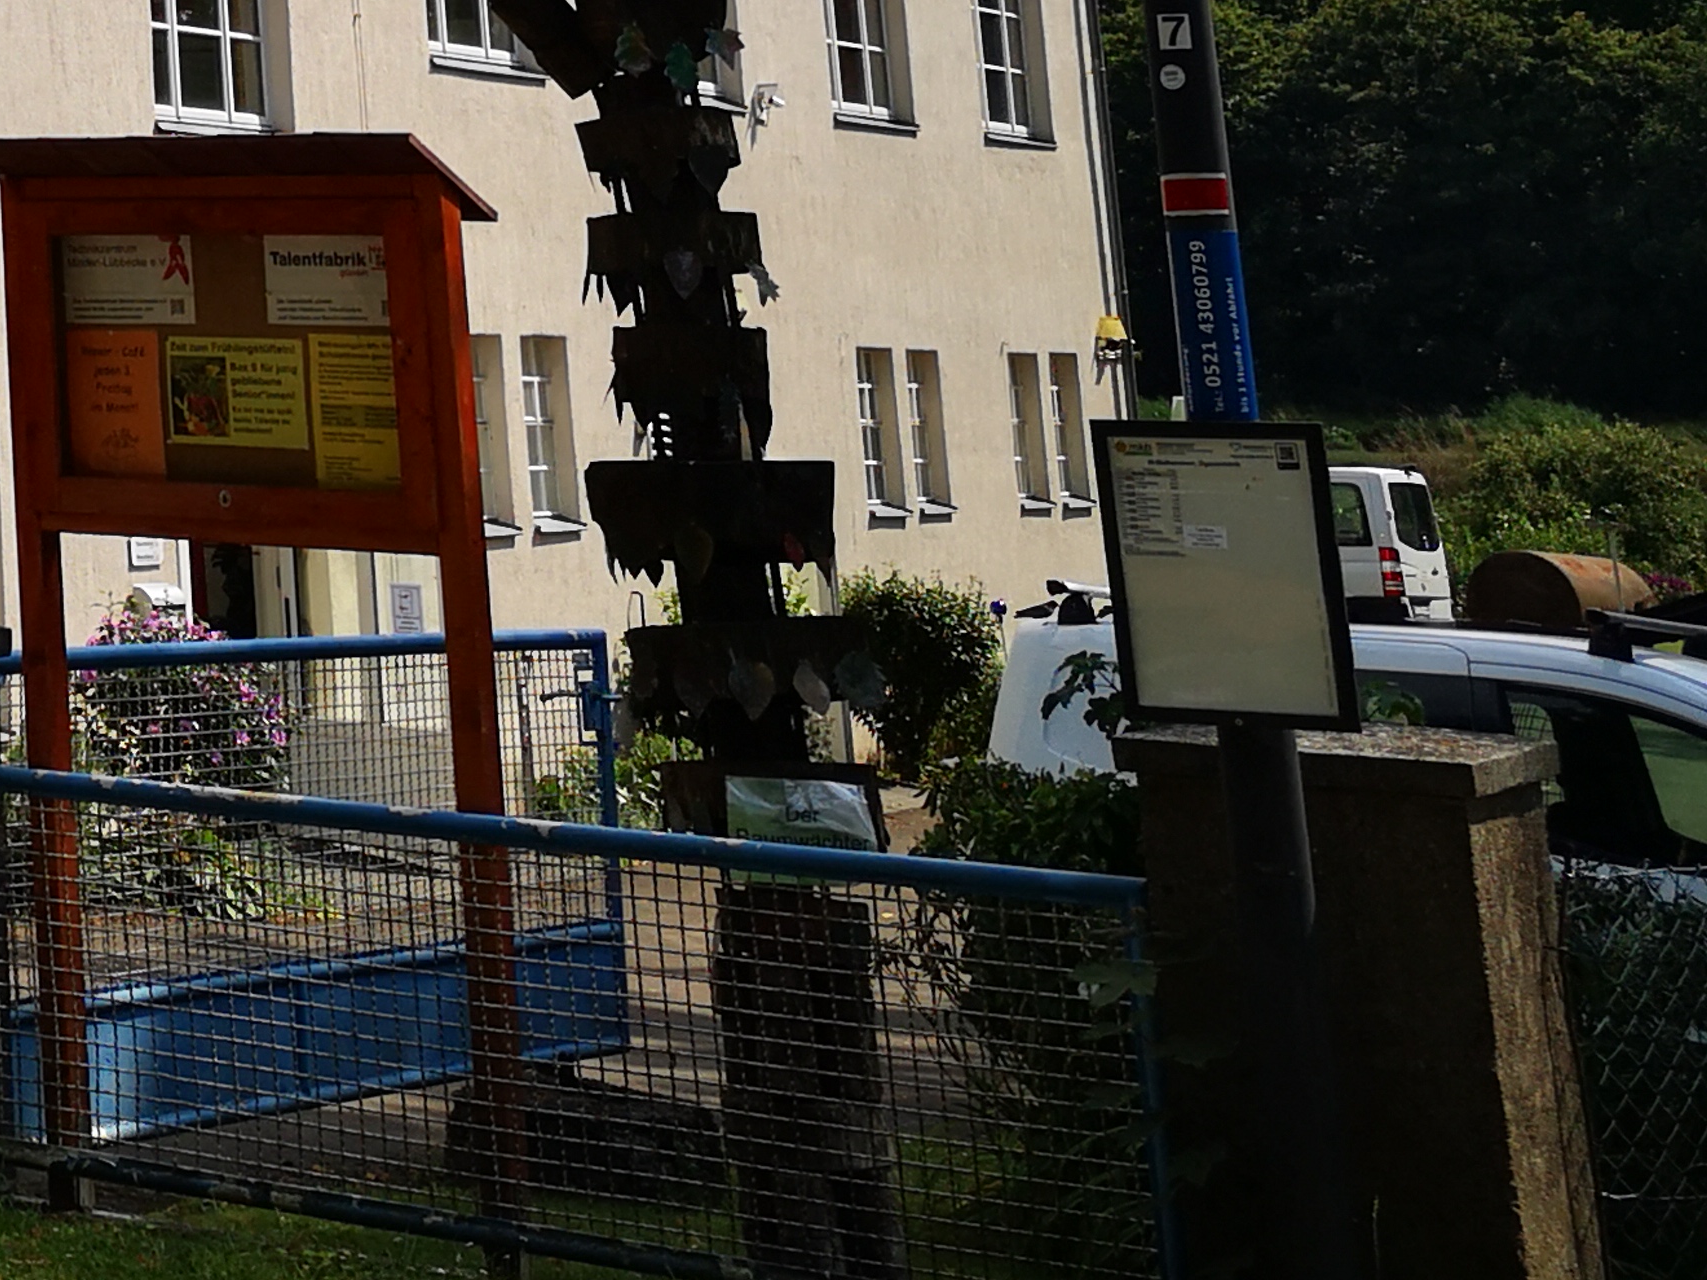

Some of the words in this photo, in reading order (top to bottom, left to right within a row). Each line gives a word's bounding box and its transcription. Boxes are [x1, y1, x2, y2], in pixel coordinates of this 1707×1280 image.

[1161, 16, 1185, 46] 7
[269, 251, 366, 267] Talentfabrik
[1189, 240, 1216, 334] 43060799
[1224, 277, 1238, 319] Abfahrt
[1230, 323, 1240, 340] vor
[1201, 341, 1222, 388] 0521
[785, 806, 820, 823] Der
